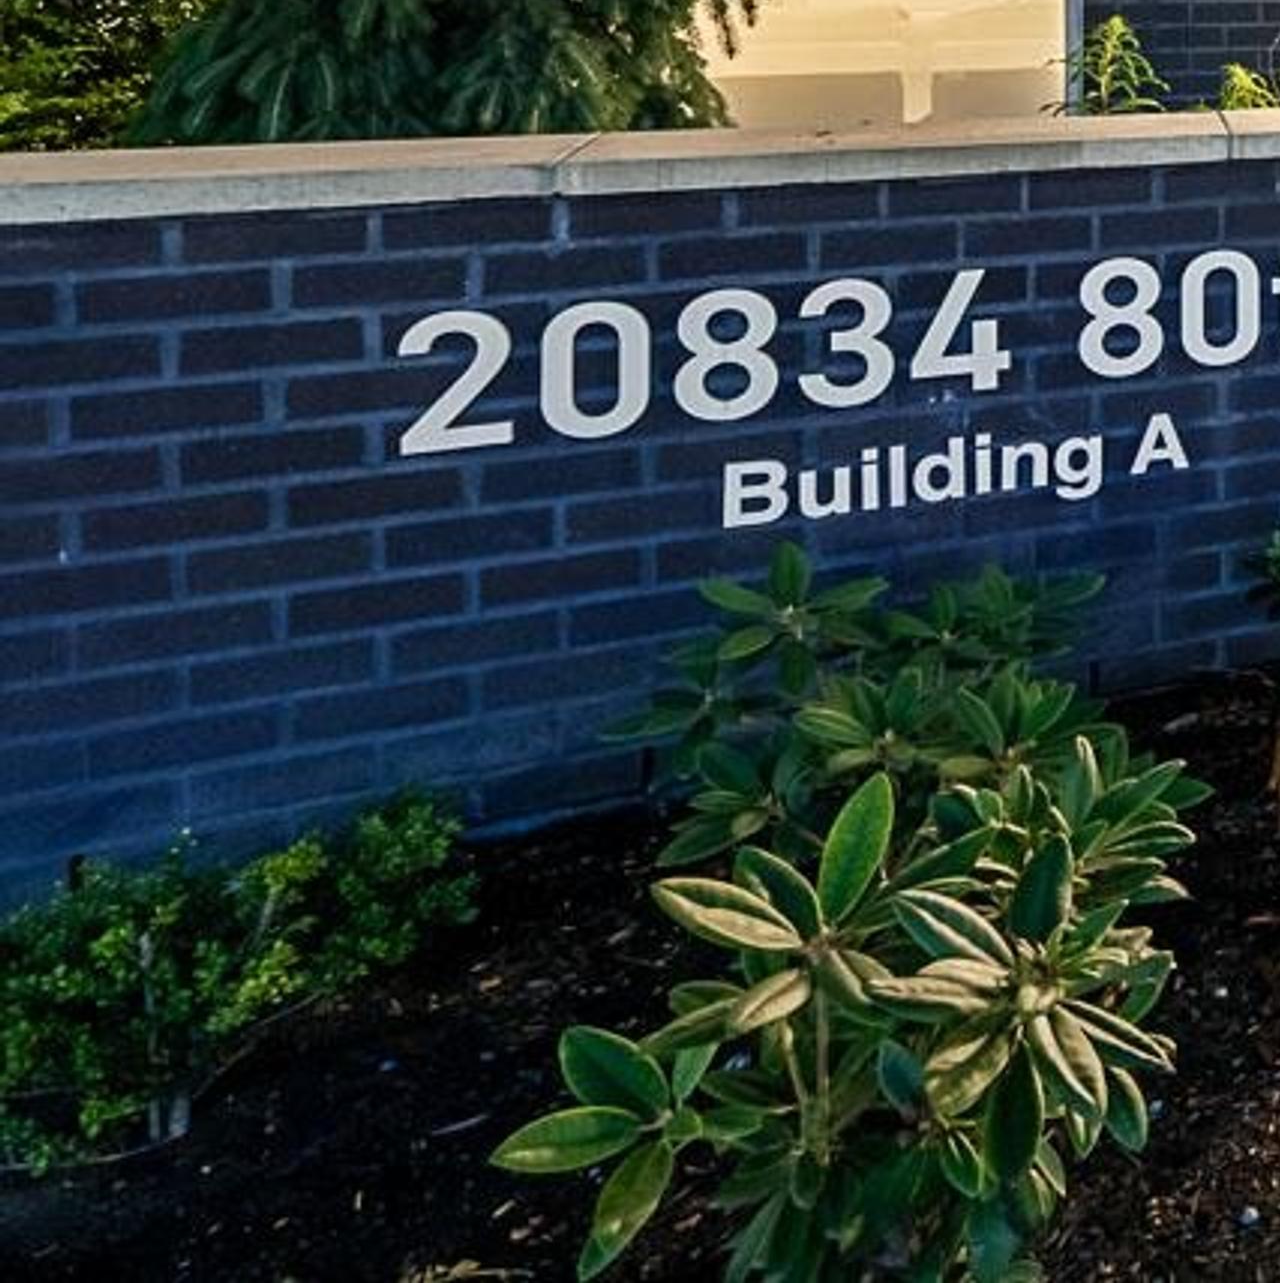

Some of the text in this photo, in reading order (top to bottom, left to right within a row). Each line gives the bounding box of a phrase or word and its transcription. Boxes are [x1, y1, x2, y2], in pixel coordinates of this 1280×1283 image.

[398, 268, 1010, 456] 20834
[722, 413, 1189, 528] Building A
